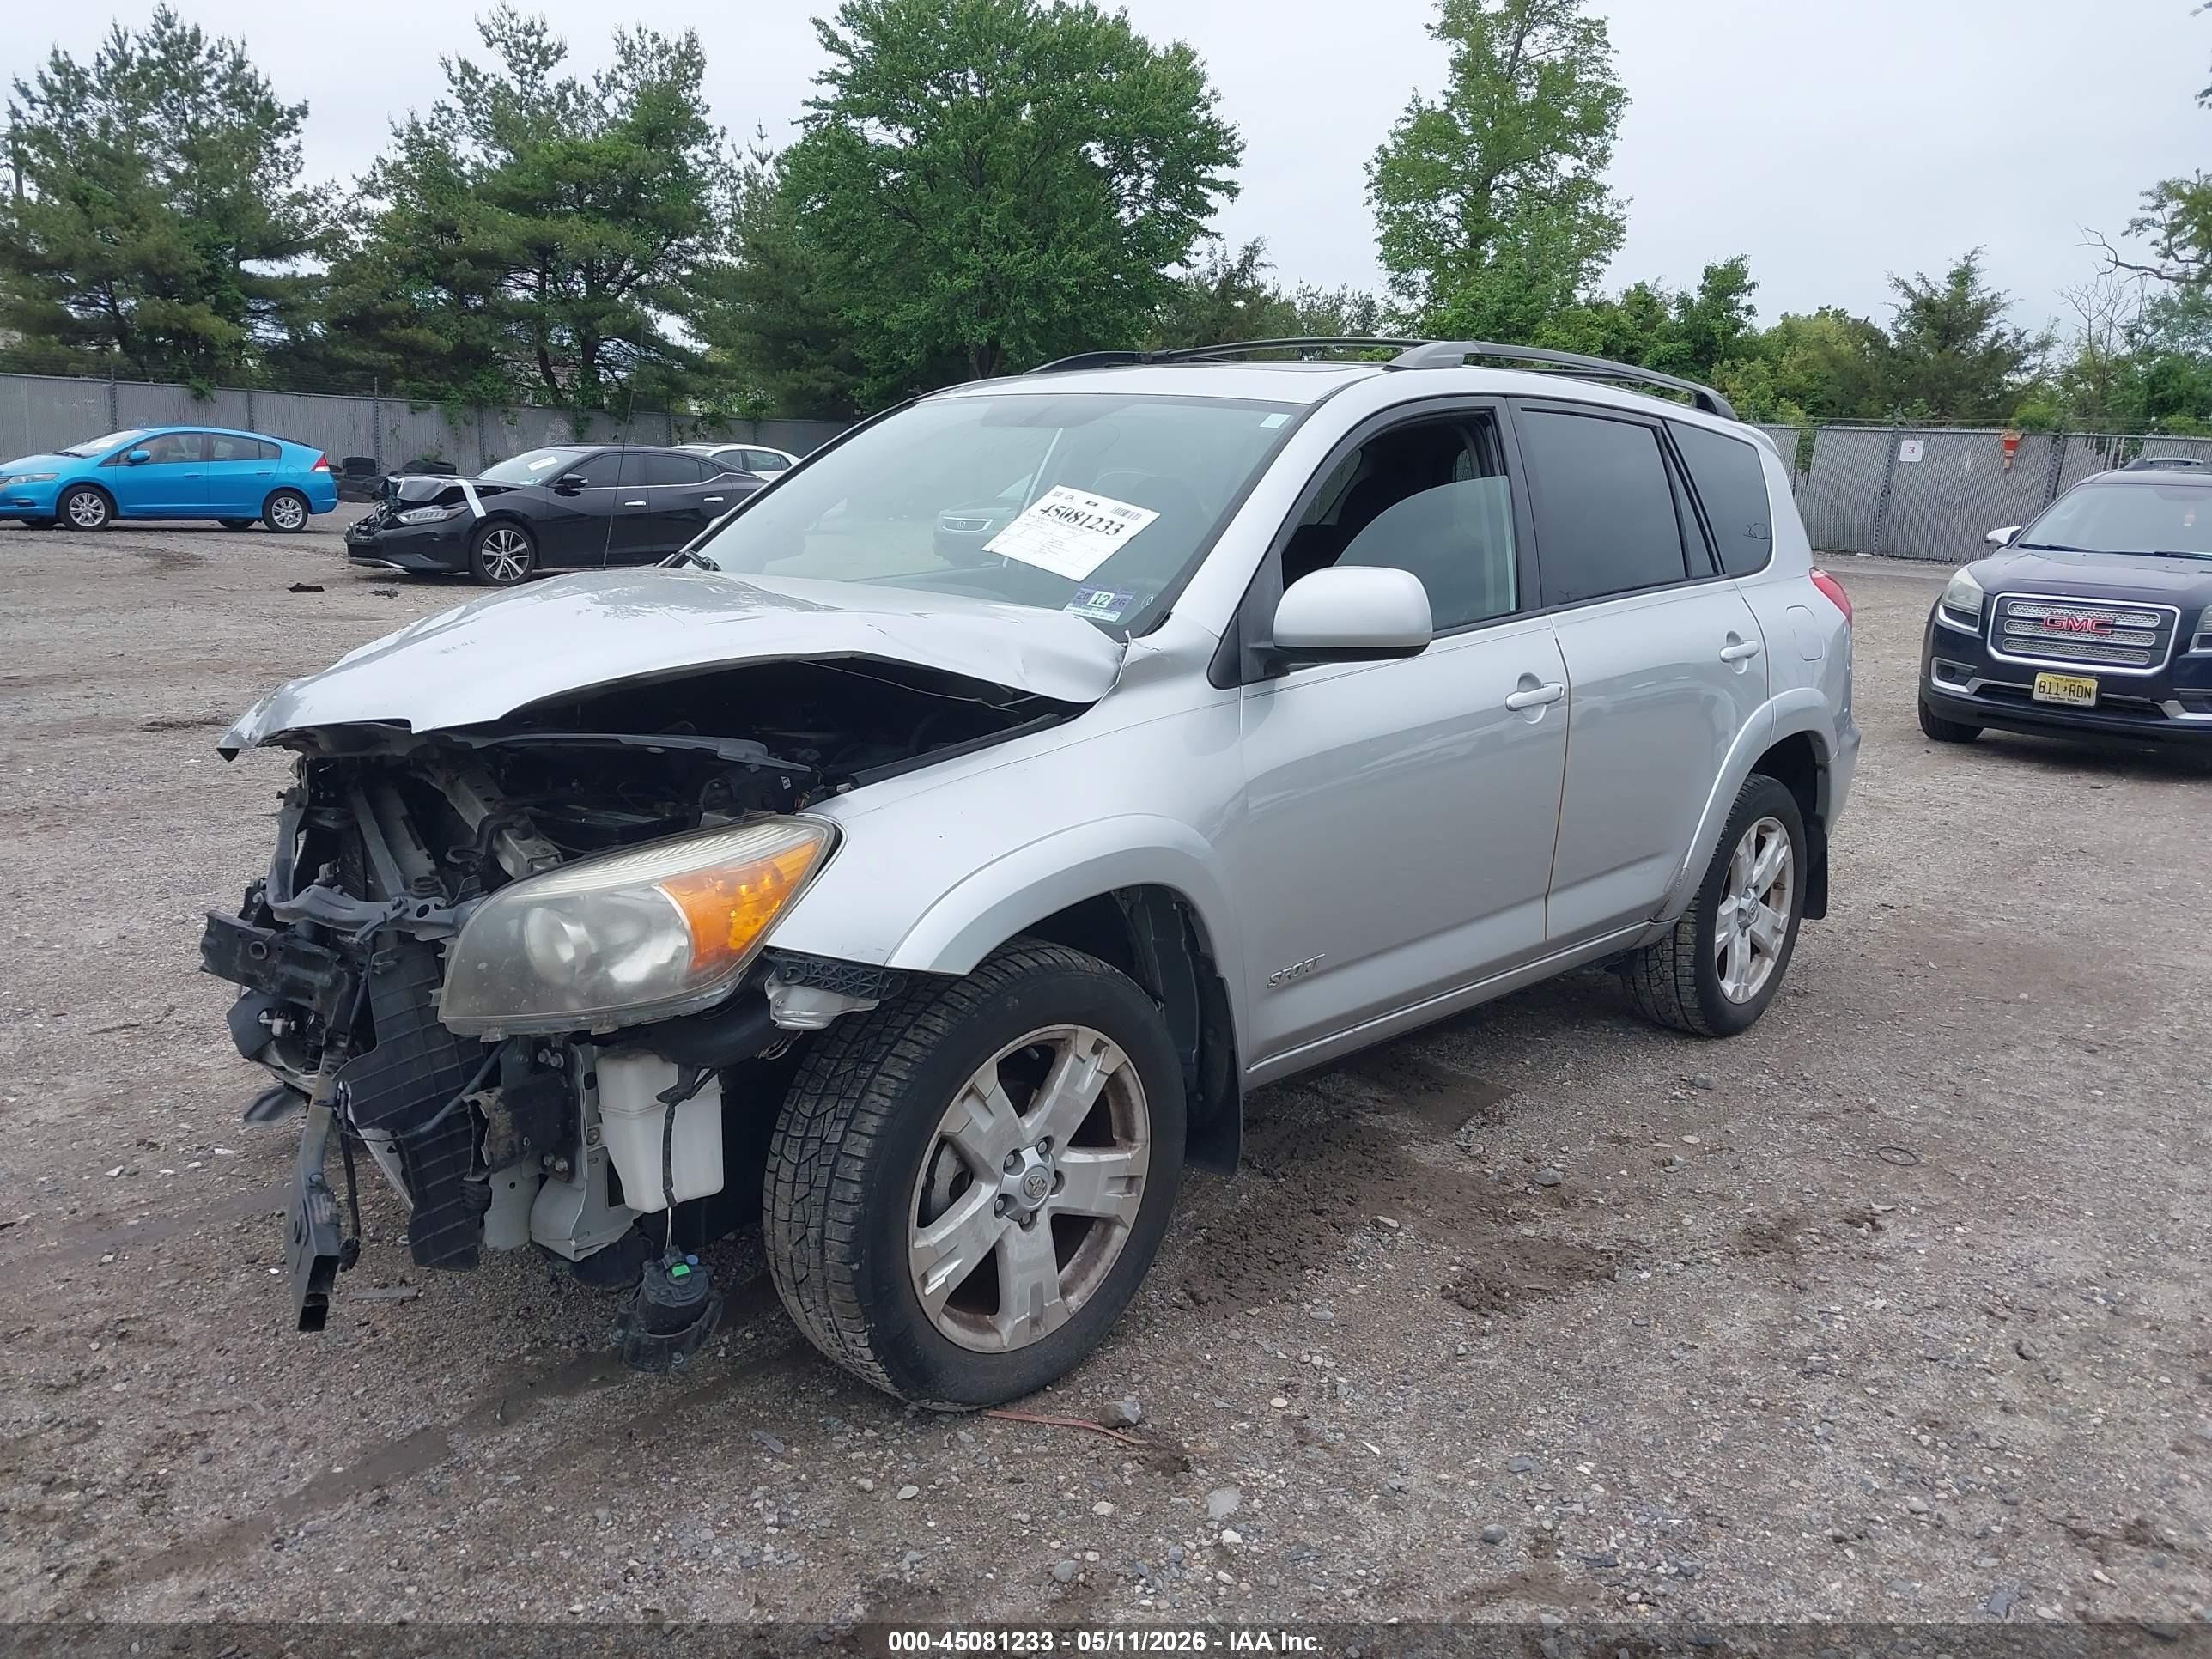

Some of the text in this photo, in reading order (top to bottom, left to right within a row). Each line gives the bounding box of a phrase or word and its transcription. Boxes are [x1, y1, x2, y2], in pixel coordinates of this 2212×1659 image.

[1908, 446, 1916, 454] 3
[1040, 503, 1126, 536] 45081233
[1091, 593, 1111, 606] 12
[2044, 614, 2112, 635] GMC
